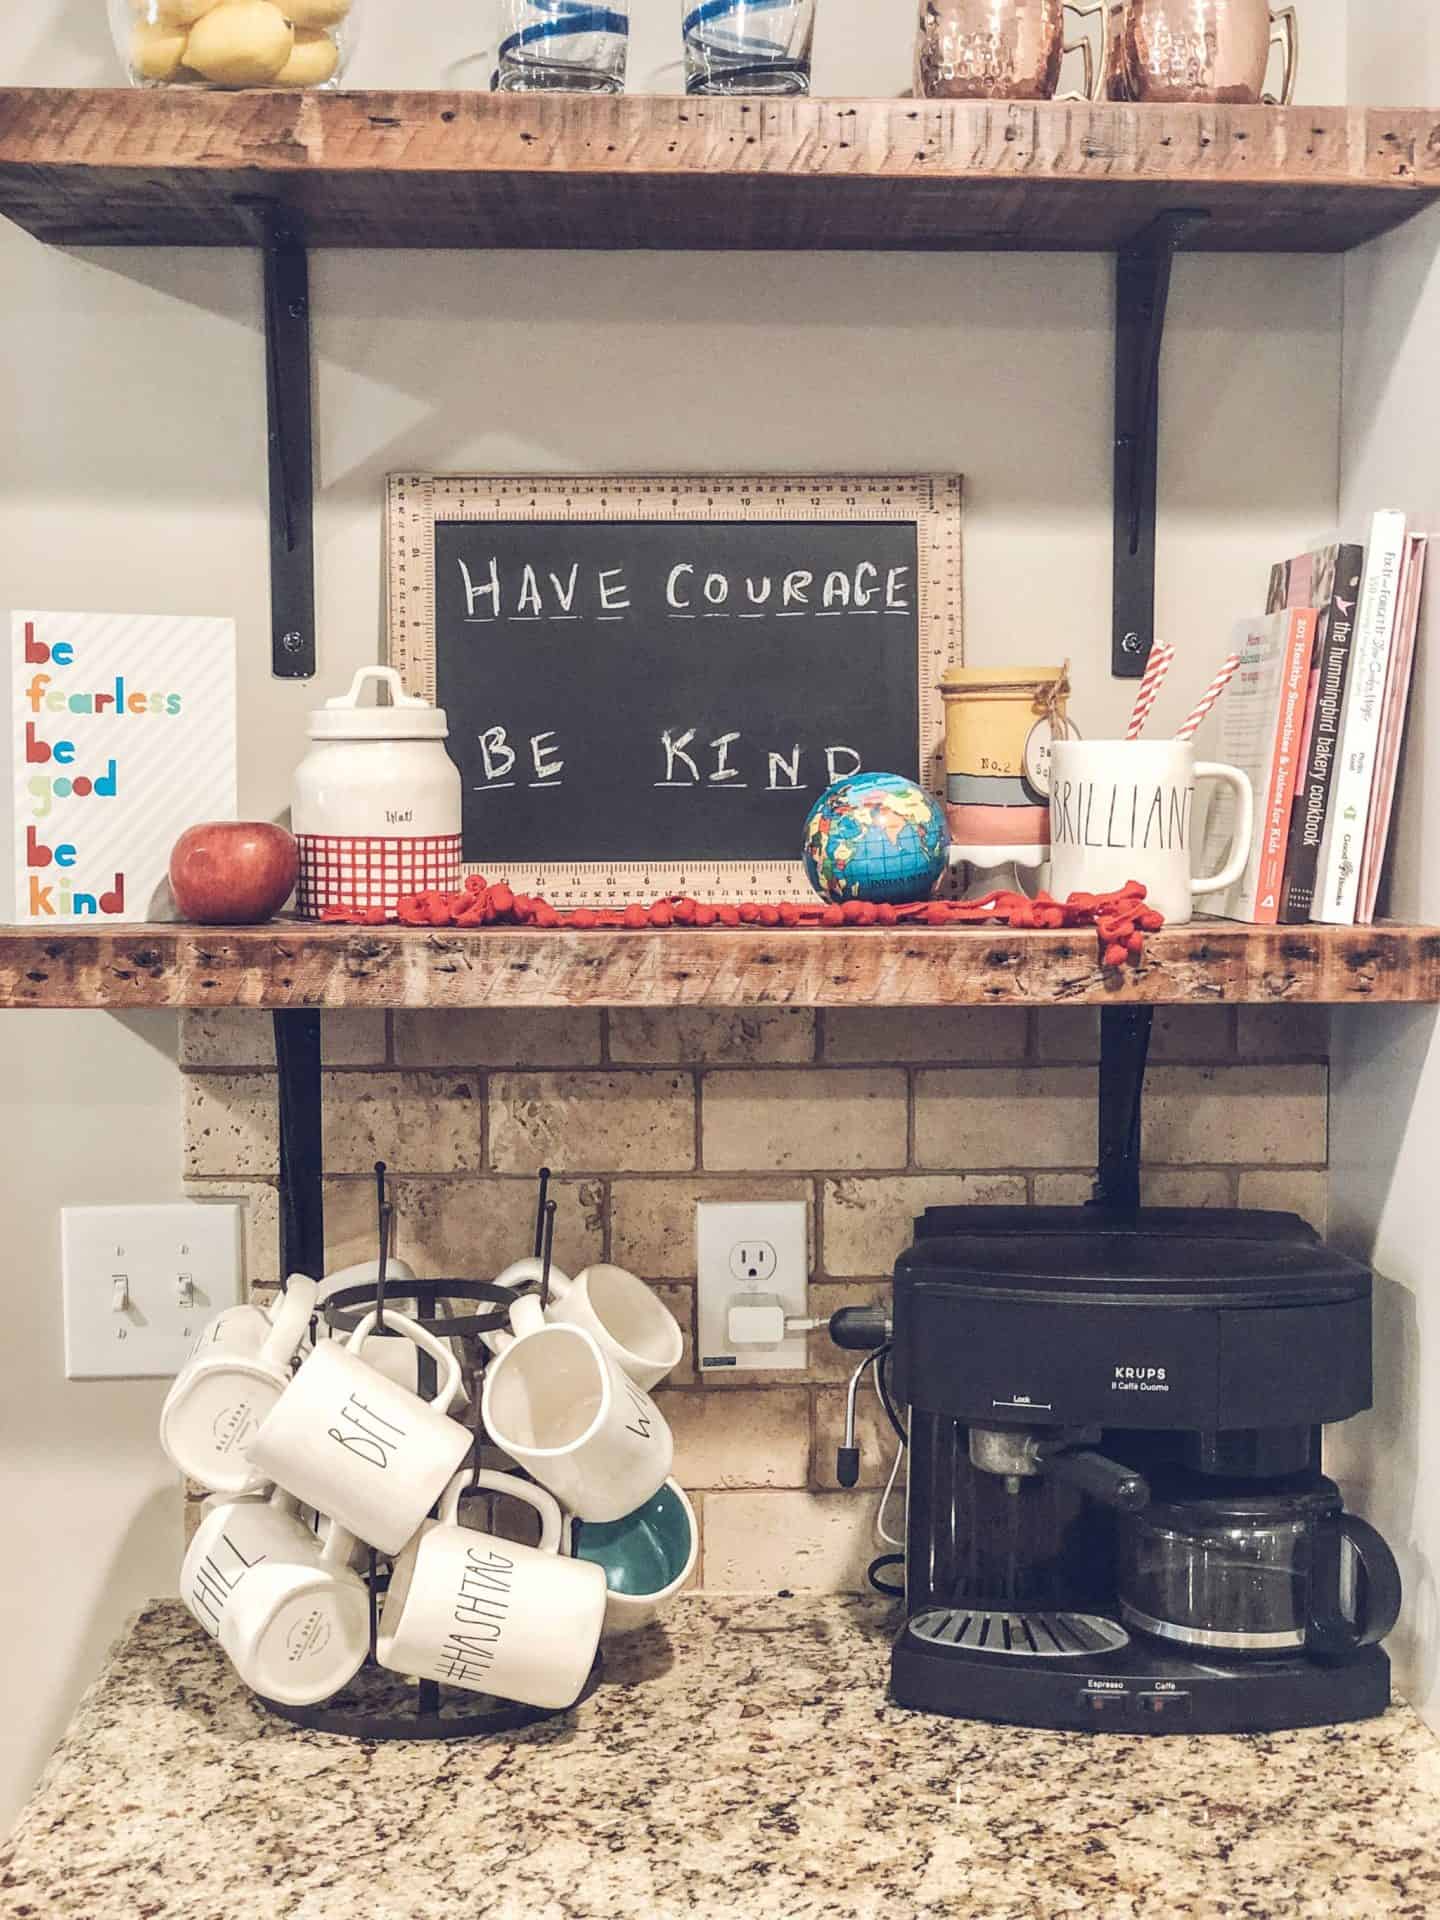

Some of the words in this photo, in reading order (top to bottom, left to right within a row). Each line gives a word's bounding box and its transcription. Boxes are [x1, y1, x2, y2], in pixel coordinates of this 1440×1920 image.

[411, 477, 420, 488] 12
[458, 499, 465, 507] 2
[495, 498, 500, 507] 3
[529, 498, 536, 507] 4
[565, 498, 572, 507] 5
[600, 498, 607, 507] 6
[636, 498, 643, 507] 7
[672, 498, 678, 507] 8
[707, 498, 713, 507] 9
[740, 498, 751, 506] 10
[776, 498, 785, 506] 11
[810, 498, 821, 506] 12
[846, 497, 856, 506] 13
[881, 497, 891, 506] 14
[412, 513, 420, 523] 11
[412, 547, 420, 558] 10
[458, 556, 632, 616] HAVE
[666, 561, 910, 609] COURAGE
[25, 622, 74, 665] be
[1332, 621, 1352, 642] the
[412, 656, 421, 664] 7
[1287, 643, 1305, 689] Healthy
[26, 673, 183, 715] fearless
[1319, 647, 1348, 734] hummingbird
[26, 721, 76, 764] be
[477, 726, 565, 780] BE
[660, 728, 863, 788] KIND
[1308, 737, 1335, 781] bakery
[28, 759, 117, 818] good
[1274, 766, 1289, 805] Juices
[1054, 781, 1195, 850] BRILLIAN
[1271, 807, 1285, 825] for
[1303, 784, 1325, 847] cookbook
[27, 825, 77, 867] be
[1267, 827, 1281, 854] Kids
[29, 872, 125, 916] kind
[536, 878, 545, 886] 12
[571, 878, 581, 886] 11
[606, 878, 616, 886] 10
[644, 876, 650, 885] 9
[680, 876, 686, 885] 8
[715, 876, 721, 885] 7
[751, 876, 757, 884] 6
[786, 876, 792, 884] 5
[1114, 1367, 1167, 1380] KRUPS
[1140, 1383, 1169, 1391] Duomo
[1013, 1394, 1031, 1403] Lock
[328, 1392, 406, 1469] BFF
[191, 1534, 267, 1638] CHILL
[433, 1548, 514, 1682] #HASHTAG
[1087, 1679, 1124, 1689] Espresso
